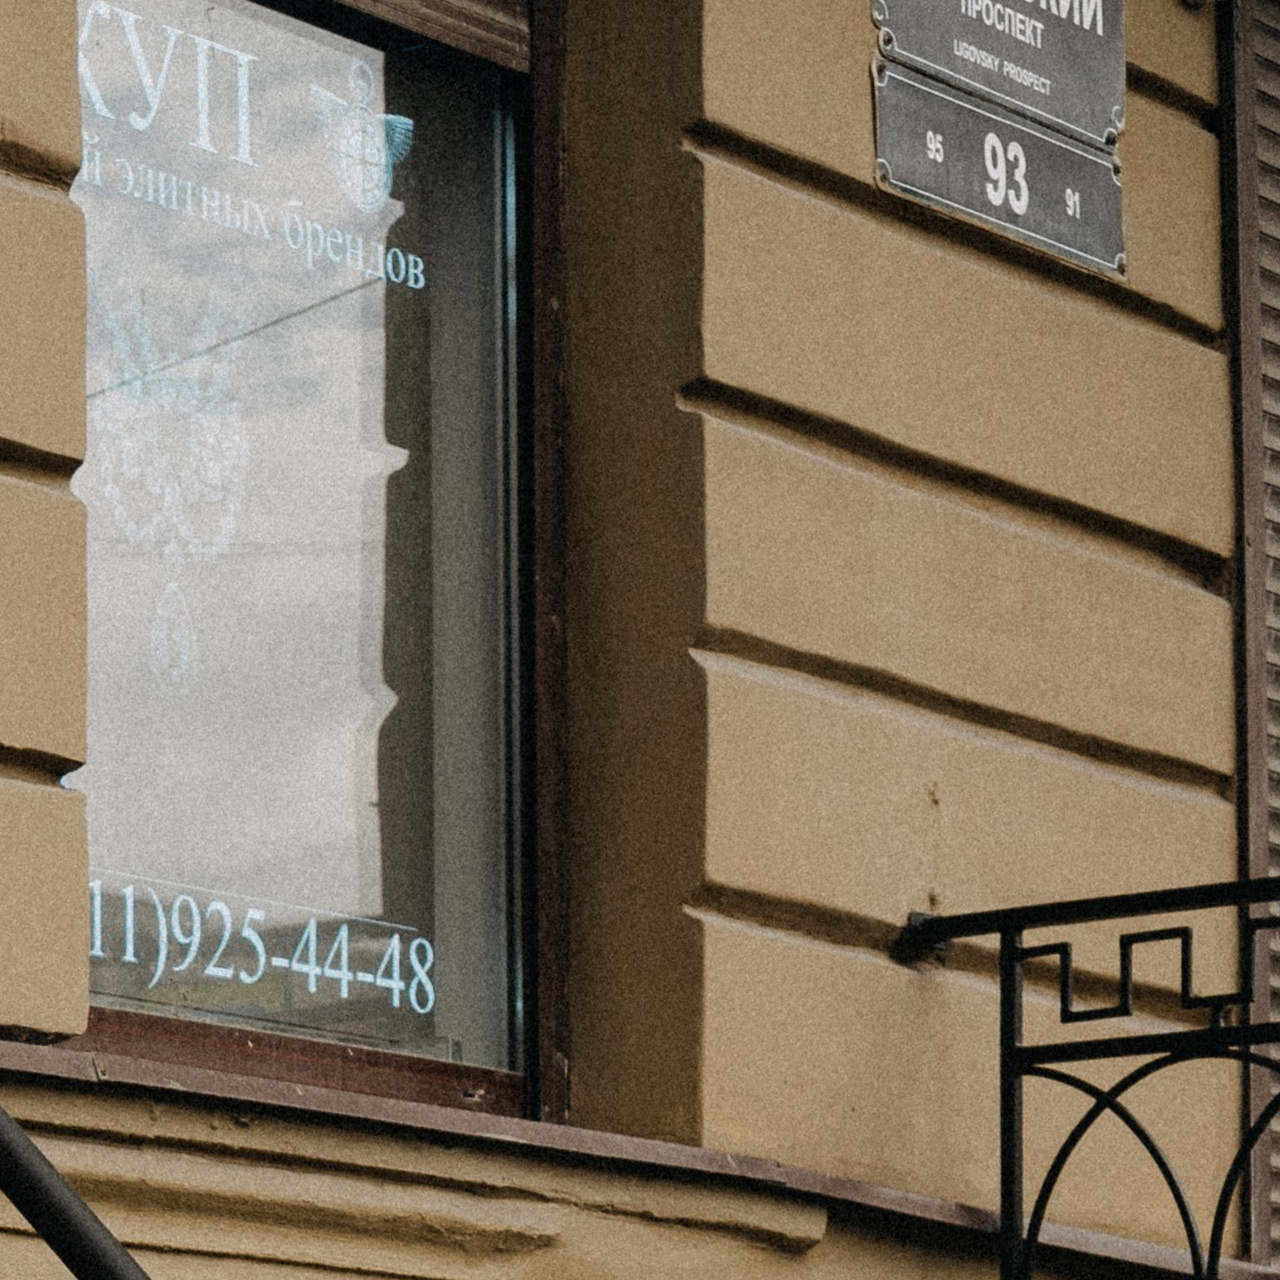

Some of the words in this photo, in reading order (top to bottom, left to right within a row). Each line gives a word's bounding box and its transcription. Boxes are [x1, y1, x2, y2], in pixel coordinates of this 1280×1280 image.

[953, 38, 1001, 73] LIGOVSKY
[1002, 60, 1052, 96] PROSPECT
[926, 130, 944, 163] 95
[984, 132, 1029, 215] 93
[1065, 187, 1081, 220] 91
[116, 157, 272, 241] элитных
[282, 198, 425, 290] брендов
